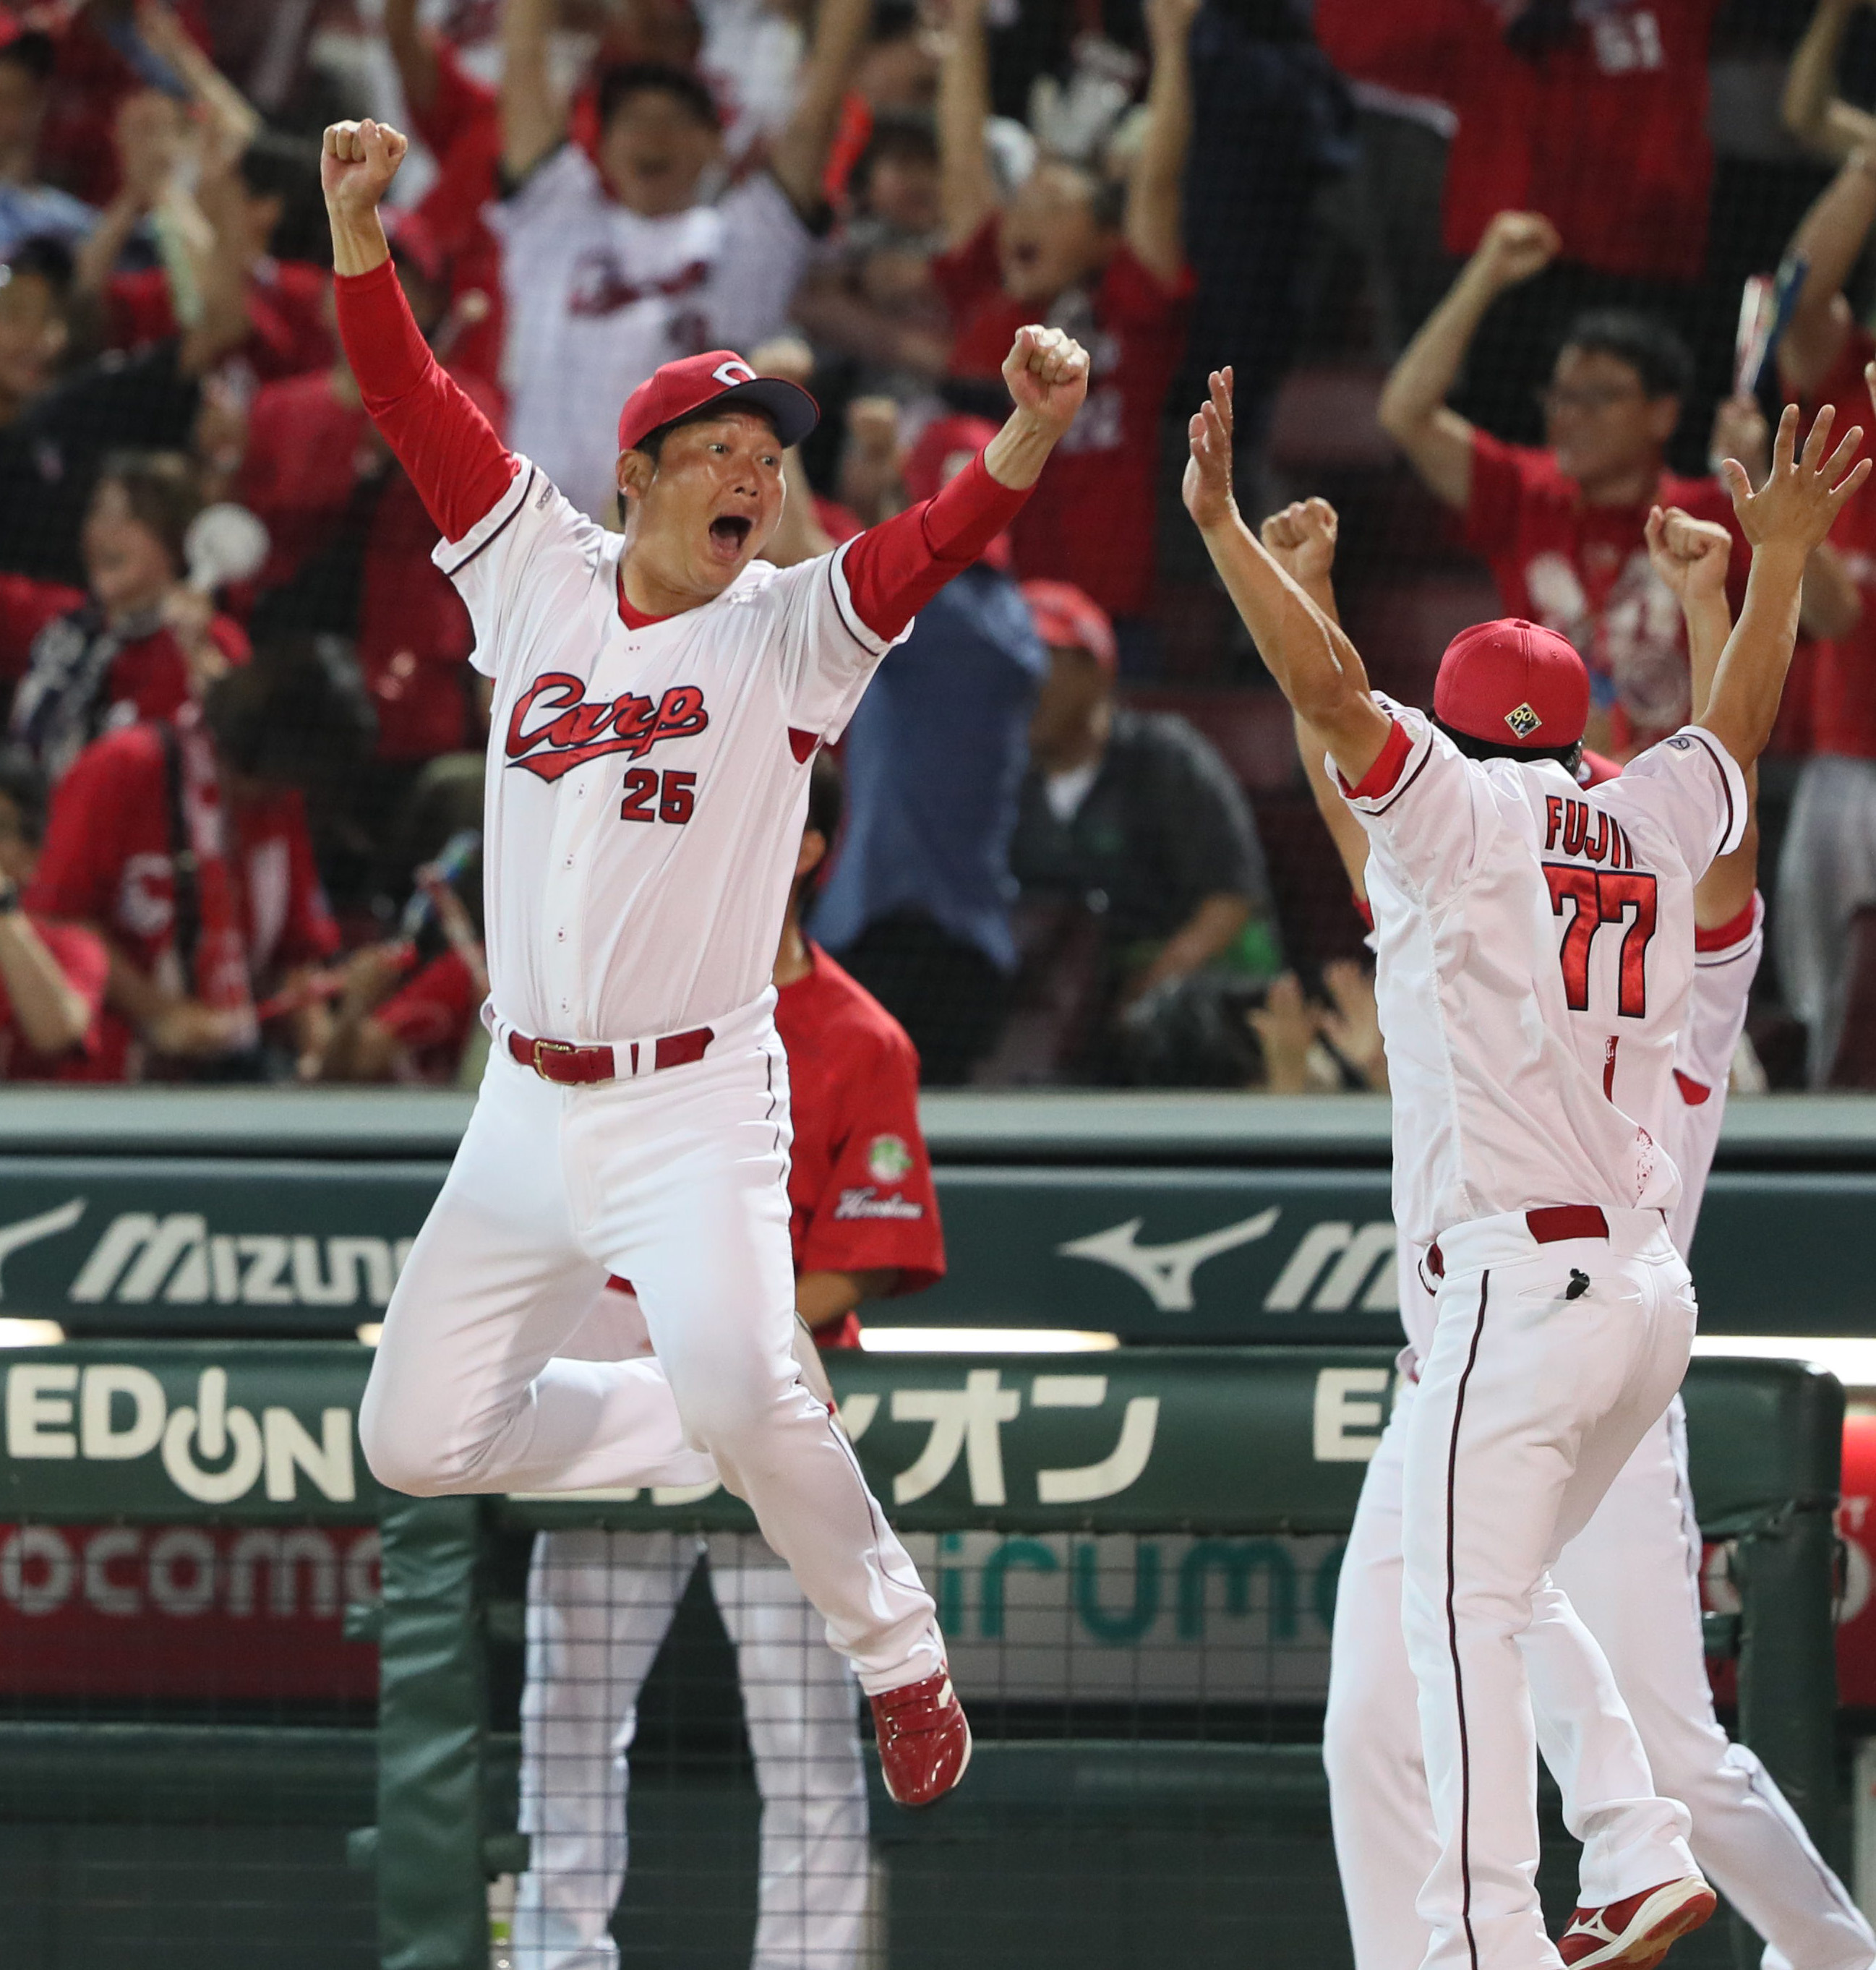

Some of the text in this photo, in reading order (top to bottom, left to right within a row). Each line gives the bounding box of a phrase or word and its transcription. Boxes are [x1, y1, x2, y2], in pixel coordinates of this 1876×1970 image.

[505, 672, 708, 784] Carp
[1514, 710, 1533, 726] 90
[620, 767, 697, 825] 25
[1541, 861, 1658, 1020] 77
[69, 1212, 417, 1306] MIZUN
[6, 1363, 356, 1504] EDION
[942, 1530, 1343, 1646] irum
